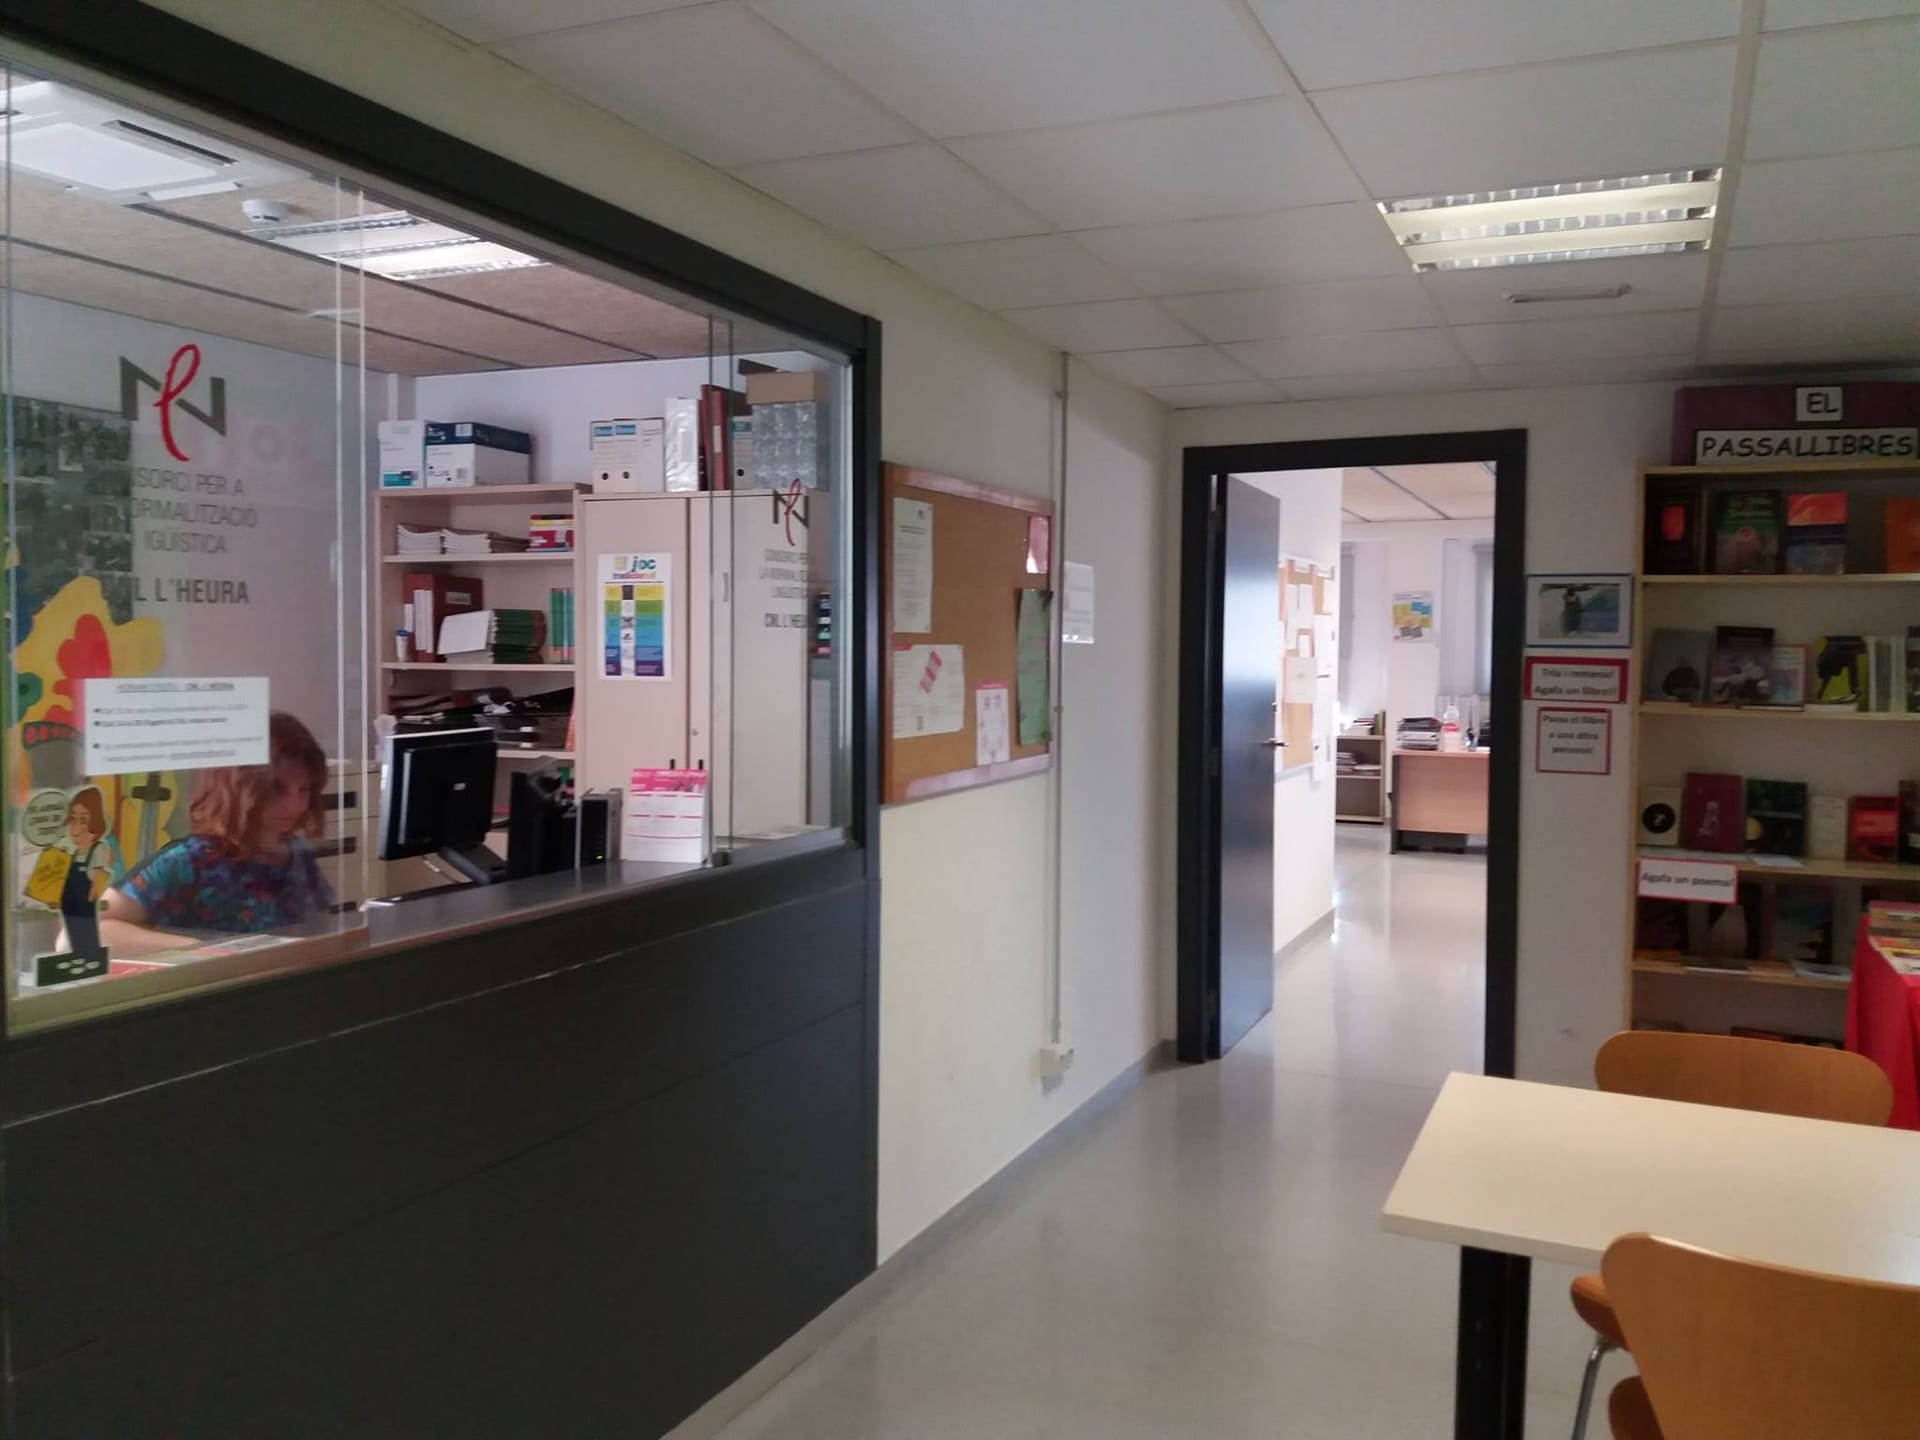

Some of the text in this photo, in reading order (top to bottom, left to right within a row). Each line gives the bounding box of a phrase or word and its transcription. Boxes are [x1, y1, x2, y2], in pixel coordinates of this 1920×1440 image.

[1806, 392, 1840, 414] EL
[1702, 434, 1913, 457] PASSALLIBRES
[196, 473, 226, 494] PER
[232, 478, 245, 497] A
[155, 577, 249, 604] L'HEURA
